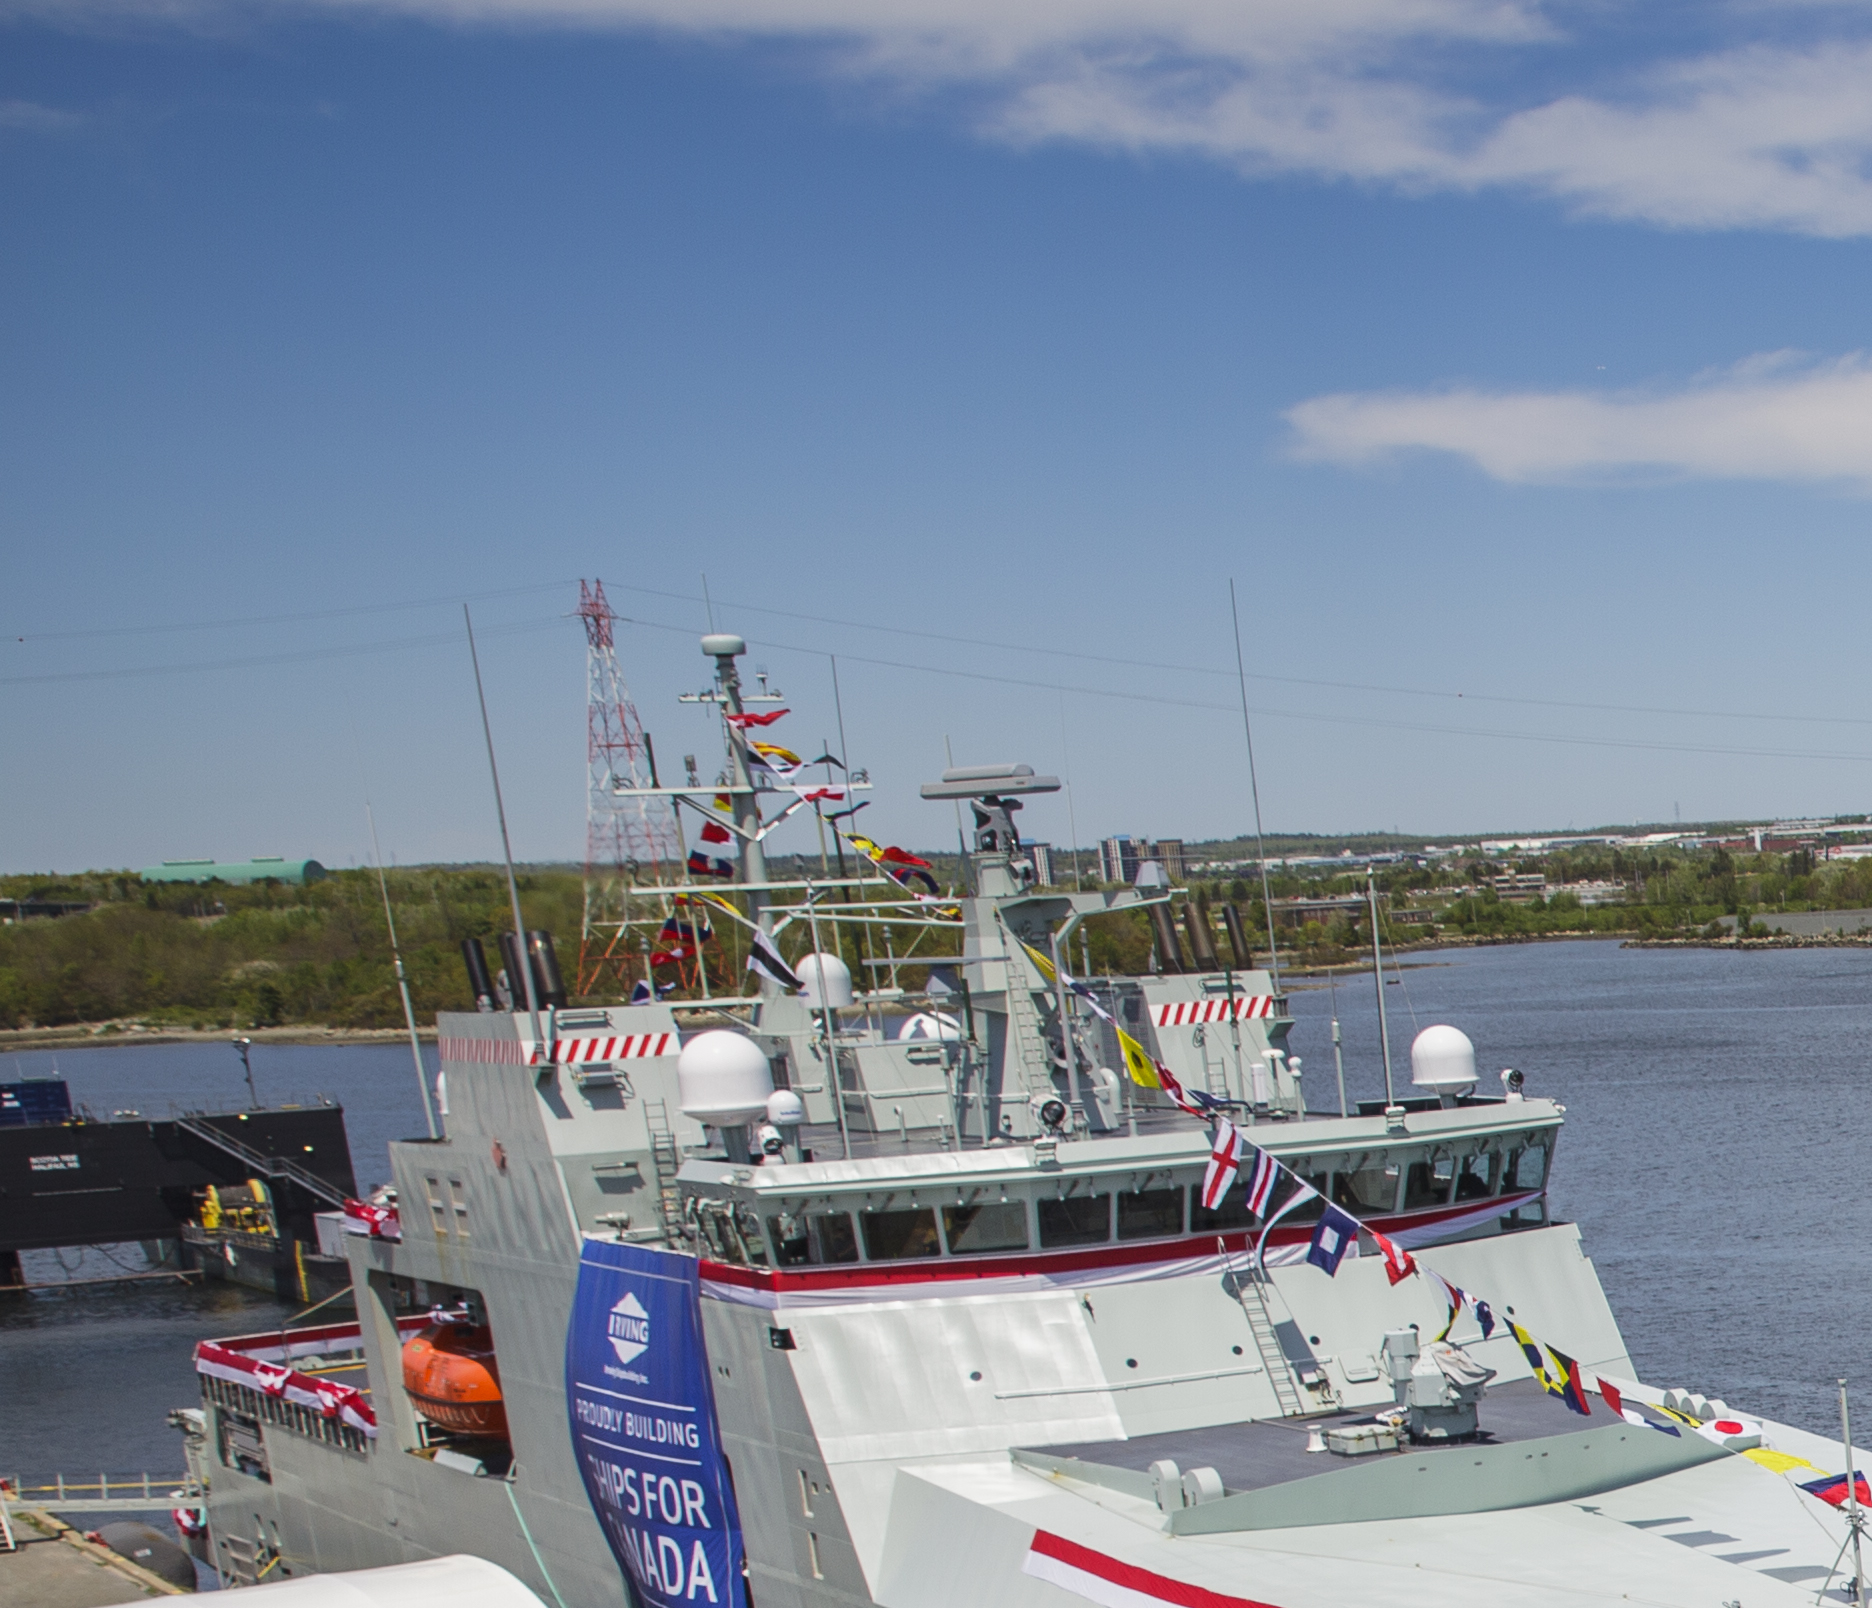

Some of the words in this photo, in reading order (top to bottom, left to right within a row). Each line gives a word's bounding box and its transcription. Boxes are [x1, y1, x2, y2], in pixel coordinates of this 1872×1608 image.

[608, 1314, 649, 1343] IRVING
[576, 1398, 623, 1434] PROUDLY
[625, 1411, 700, 1449] BUILDING
[642, 1472, 712, 1529] FOR
